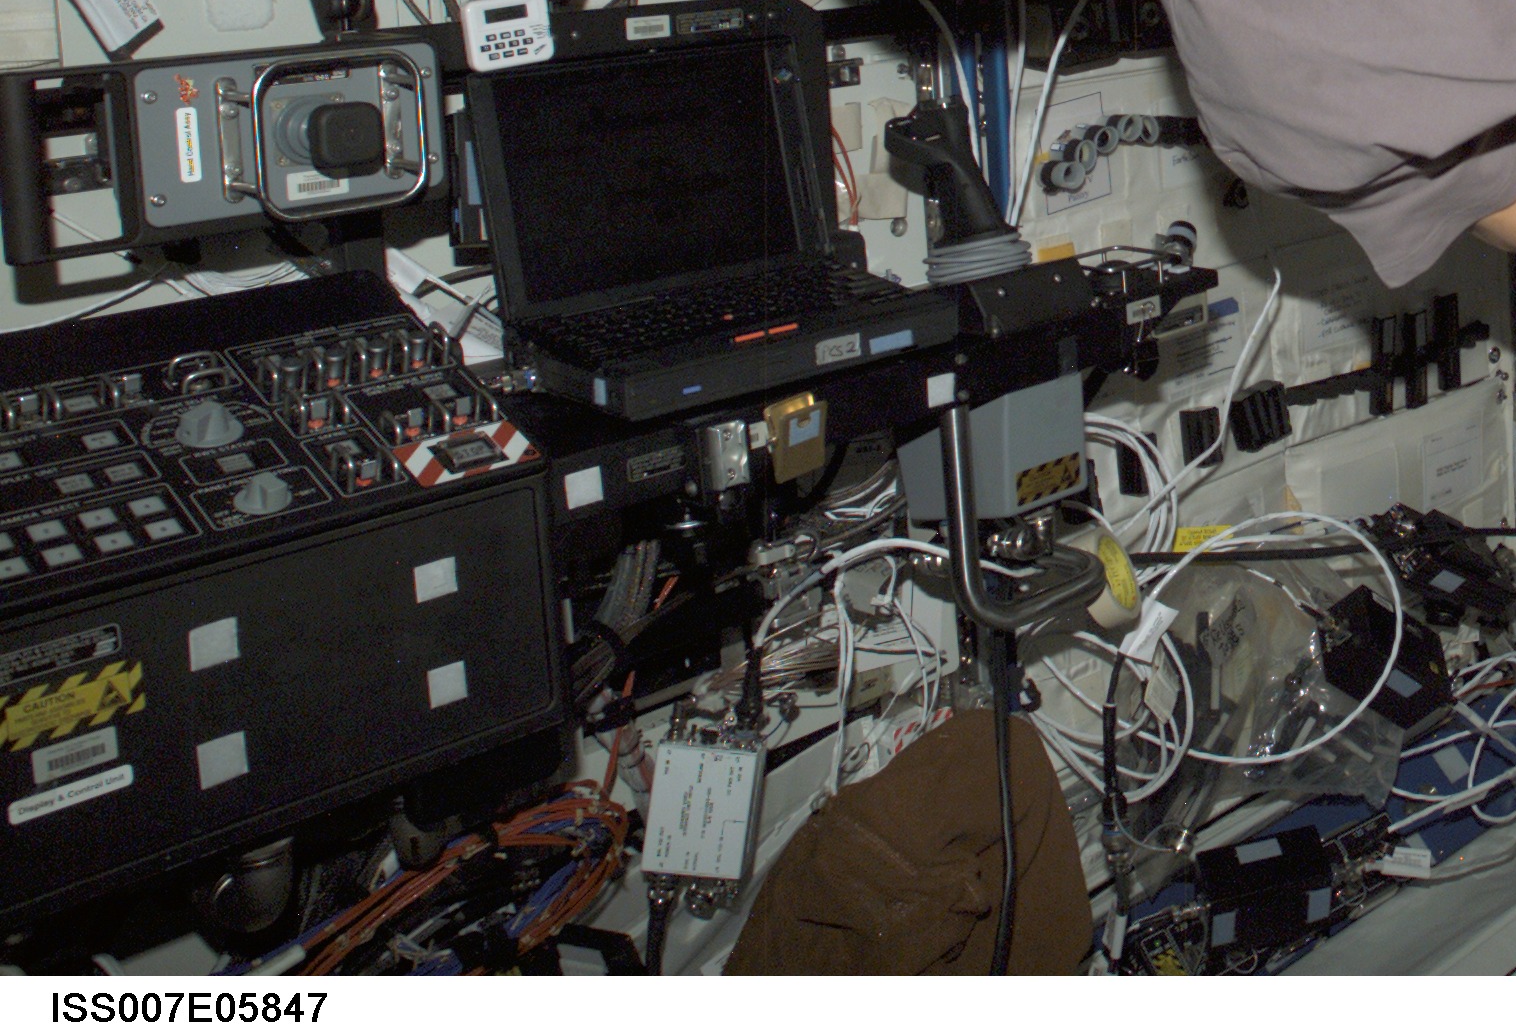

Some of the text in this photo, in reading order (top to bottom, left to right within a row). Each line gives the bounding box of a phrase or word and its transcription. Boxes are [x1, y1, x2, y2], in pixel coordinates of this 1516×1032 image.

[186, 129, 194, 156] Control
[187, 159, 195, 177] Hand
[23, 690, 75, 713] CAUTION
[18, 799, 55, 816] Display
[67, 780, 104, 798] Control
[105, 773, 125, 785] Unit
